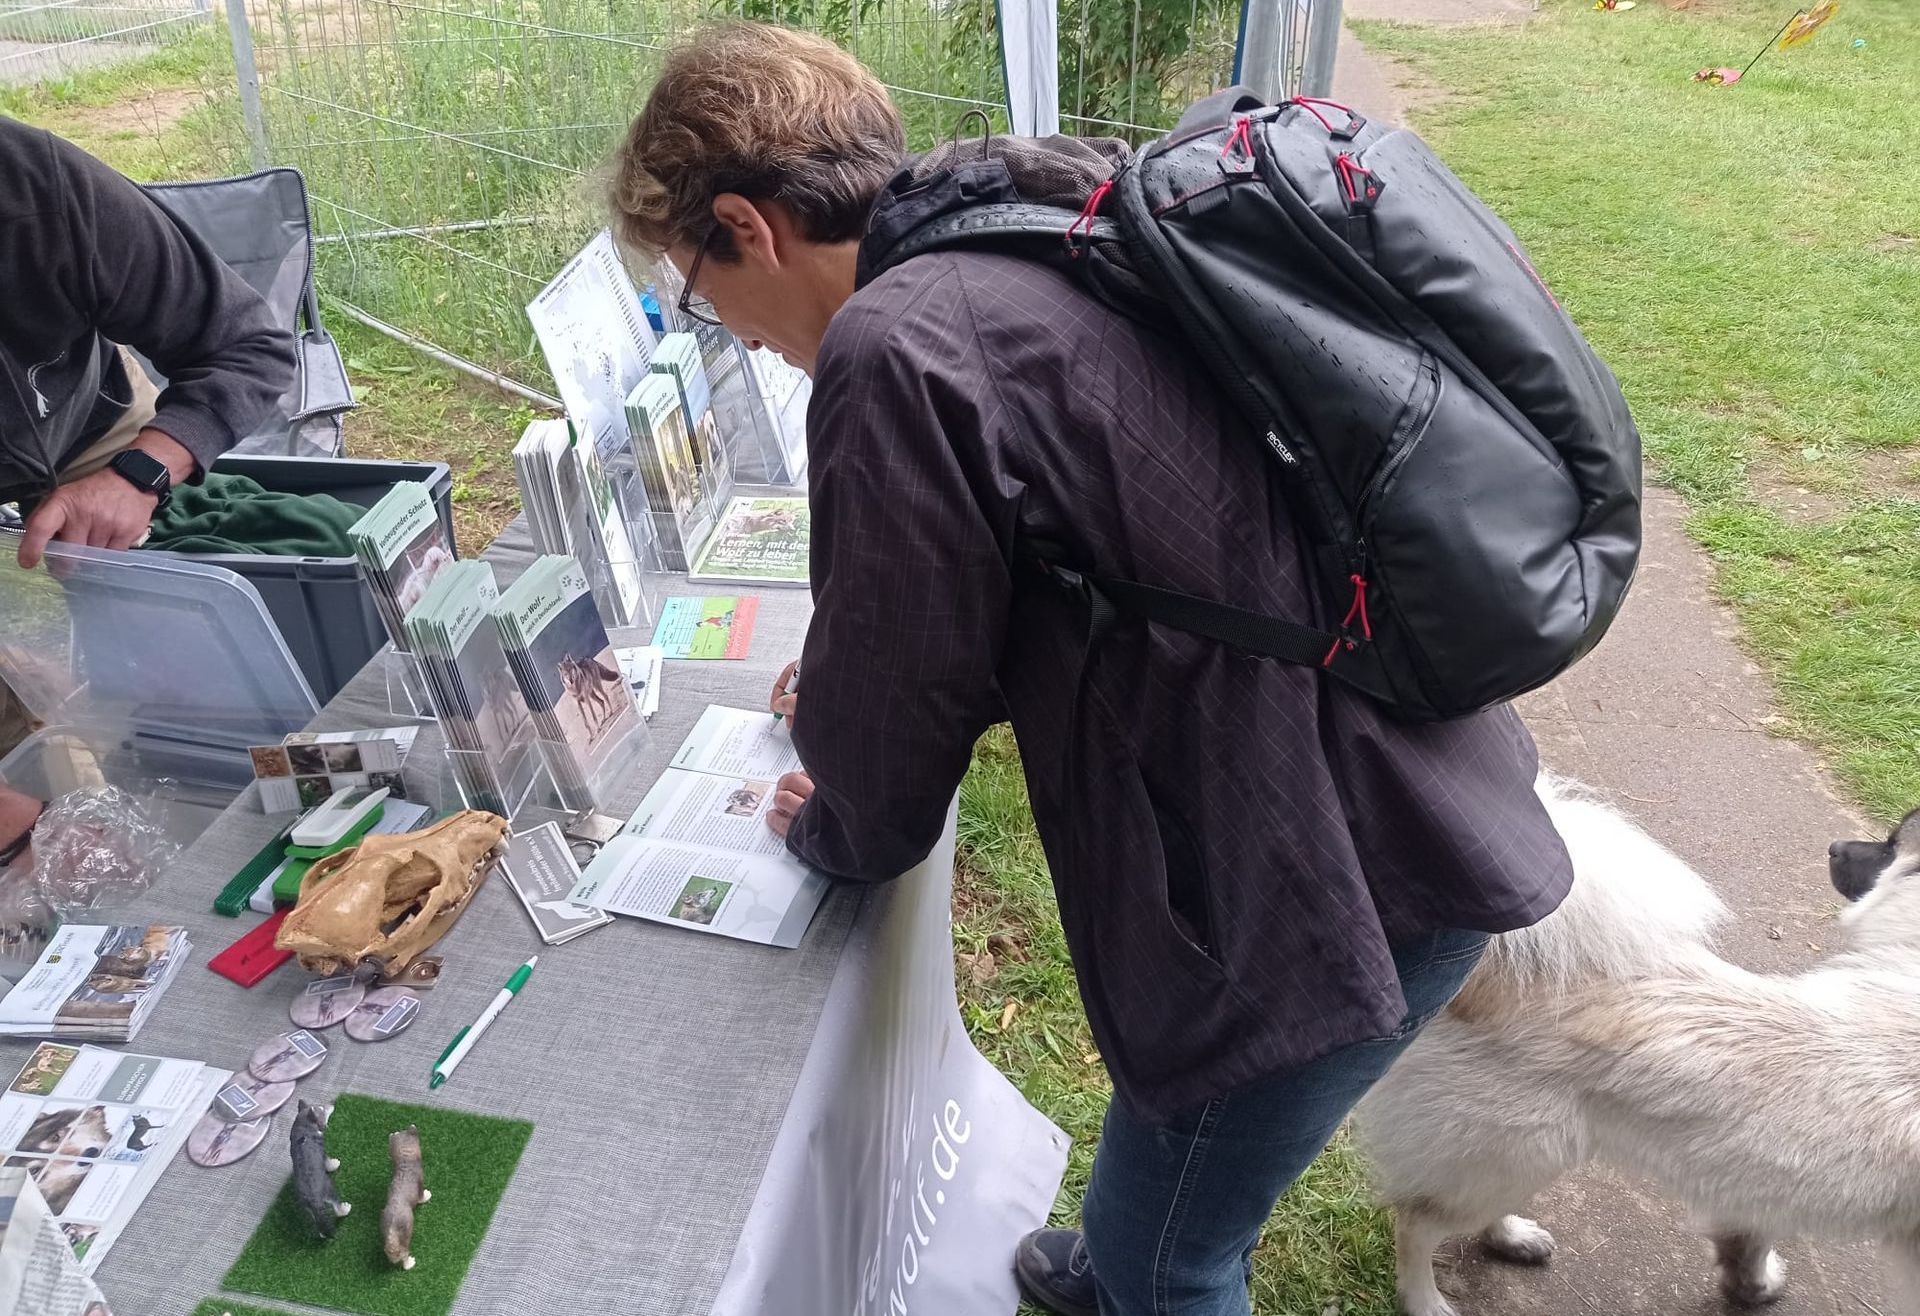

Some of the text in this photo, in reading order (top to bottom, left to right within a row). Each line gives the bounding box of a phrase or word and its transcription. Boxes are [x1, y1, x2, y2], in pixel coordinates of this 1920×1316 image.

[408, 499, 427, 517] Schutz
[766, 540, 789, 550] mit
[716, 547, 747, 557] Wolf
[762, 549, 798, 560] leben
[520, 611, 529, 625] Der
[528, 595, 541, 614] Wolf
